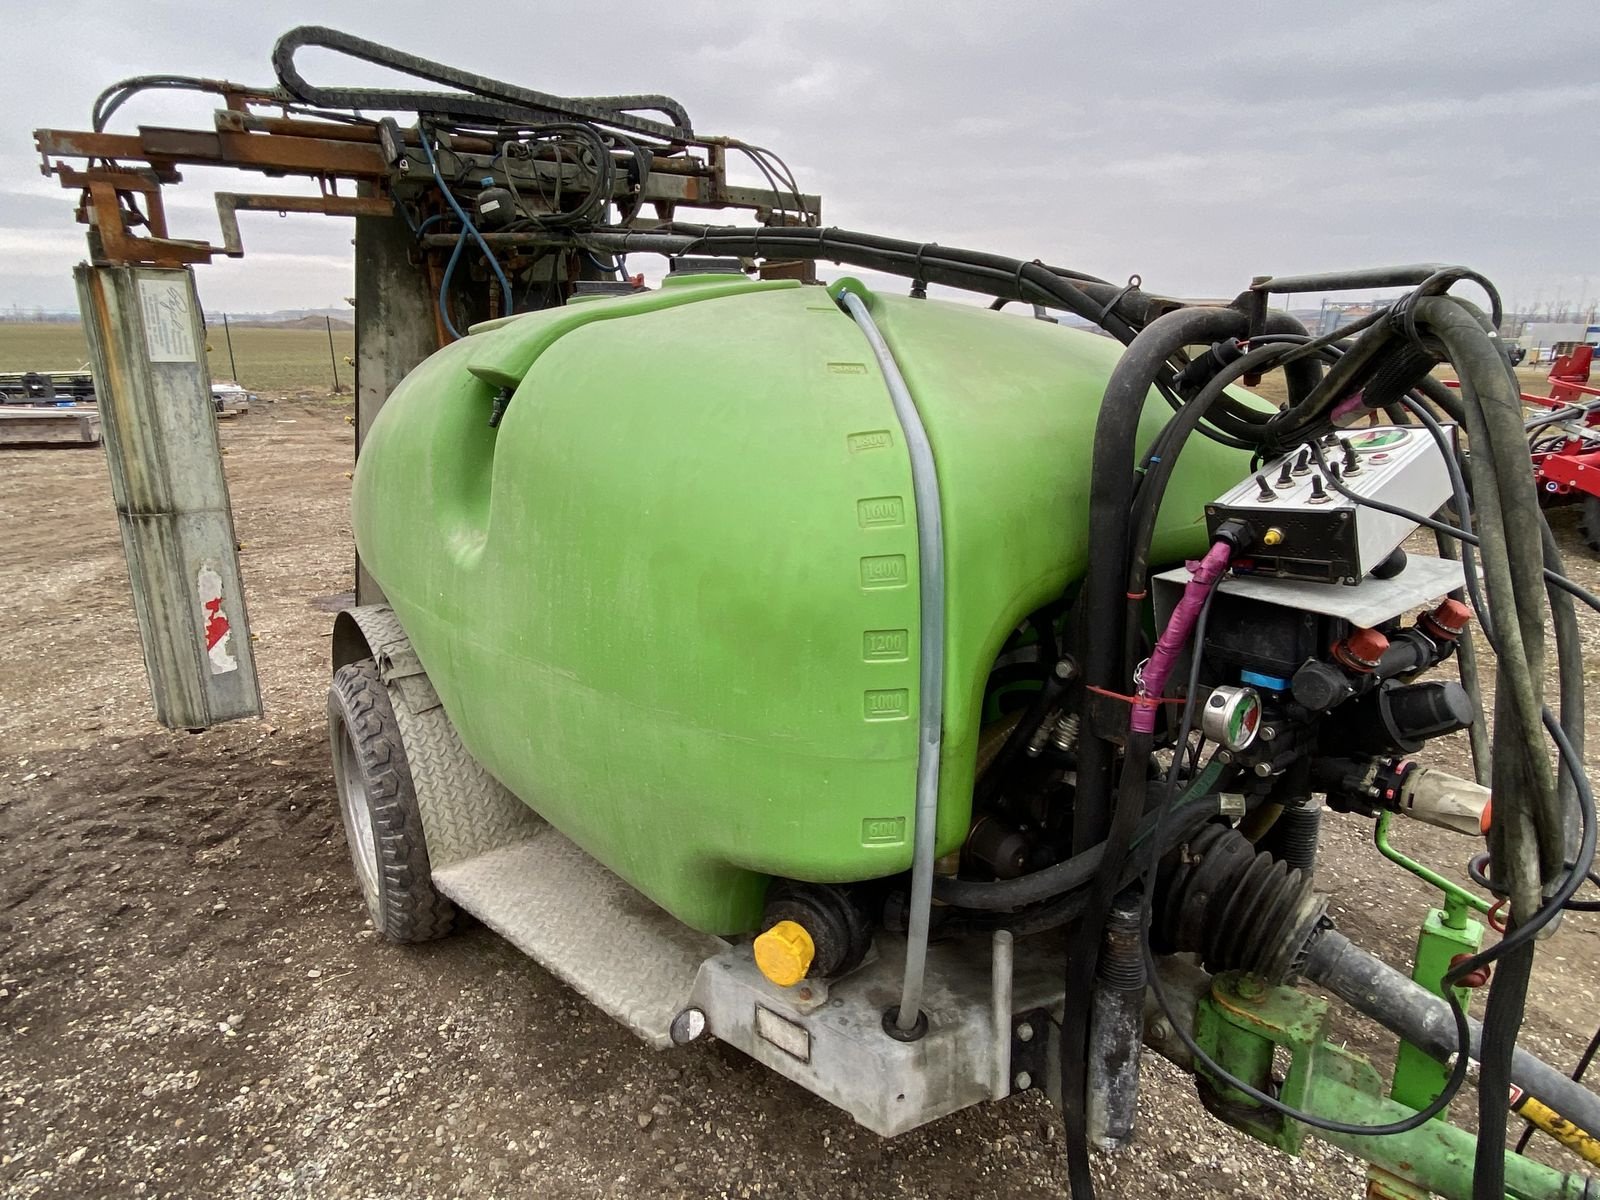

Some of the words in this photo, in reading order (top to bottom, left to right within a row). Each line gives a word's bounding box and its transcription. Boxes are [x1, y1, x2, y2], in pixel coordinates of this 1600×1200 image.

[863, 503, 897, 519] 1600
[866, 561, 900, 577] 1400
[869, 635, 900, 650] 1200
[869, 694, 901, 710] 1000
[869, 821, 897, 836] 600
